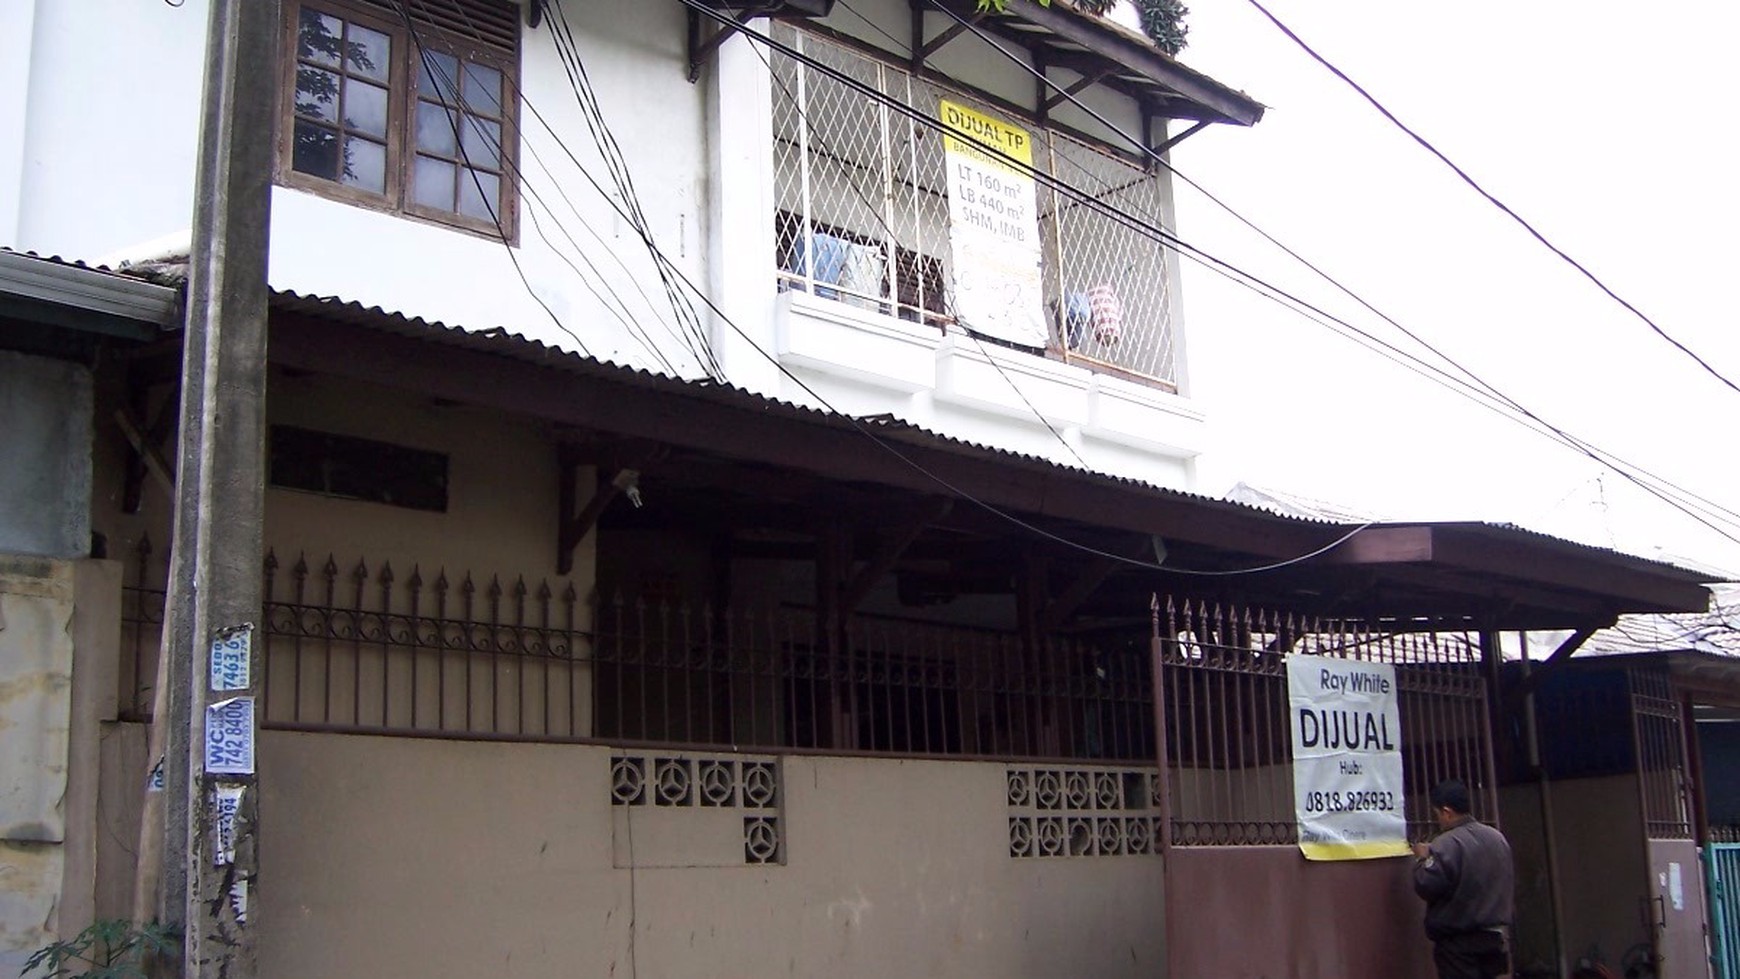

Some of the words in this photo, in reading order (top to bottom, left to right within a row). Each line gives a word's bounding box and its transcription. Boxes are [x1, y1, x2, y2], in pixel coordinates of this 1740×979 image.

[947, 107, 1003, 143] DIJUAL
[1005, 130, 1023, 150] TP
[958, 163, 972, 182] LT
[977, 171, 1000, 193] 160
[959, 184, 976, 204] LB
[979, 193, 1004, 213] 440
[1320, 668, 1349, 695] Ray
[1351, 671, 1390, 695] White
[225, 703, 243, 736] 8400
[1300, 708, 1394, 751] DIJUAL
[210, 729, 224, 765] WC
[225, 740, 243, 765] 742
[1339, 761, 1363, 776] Hub:
